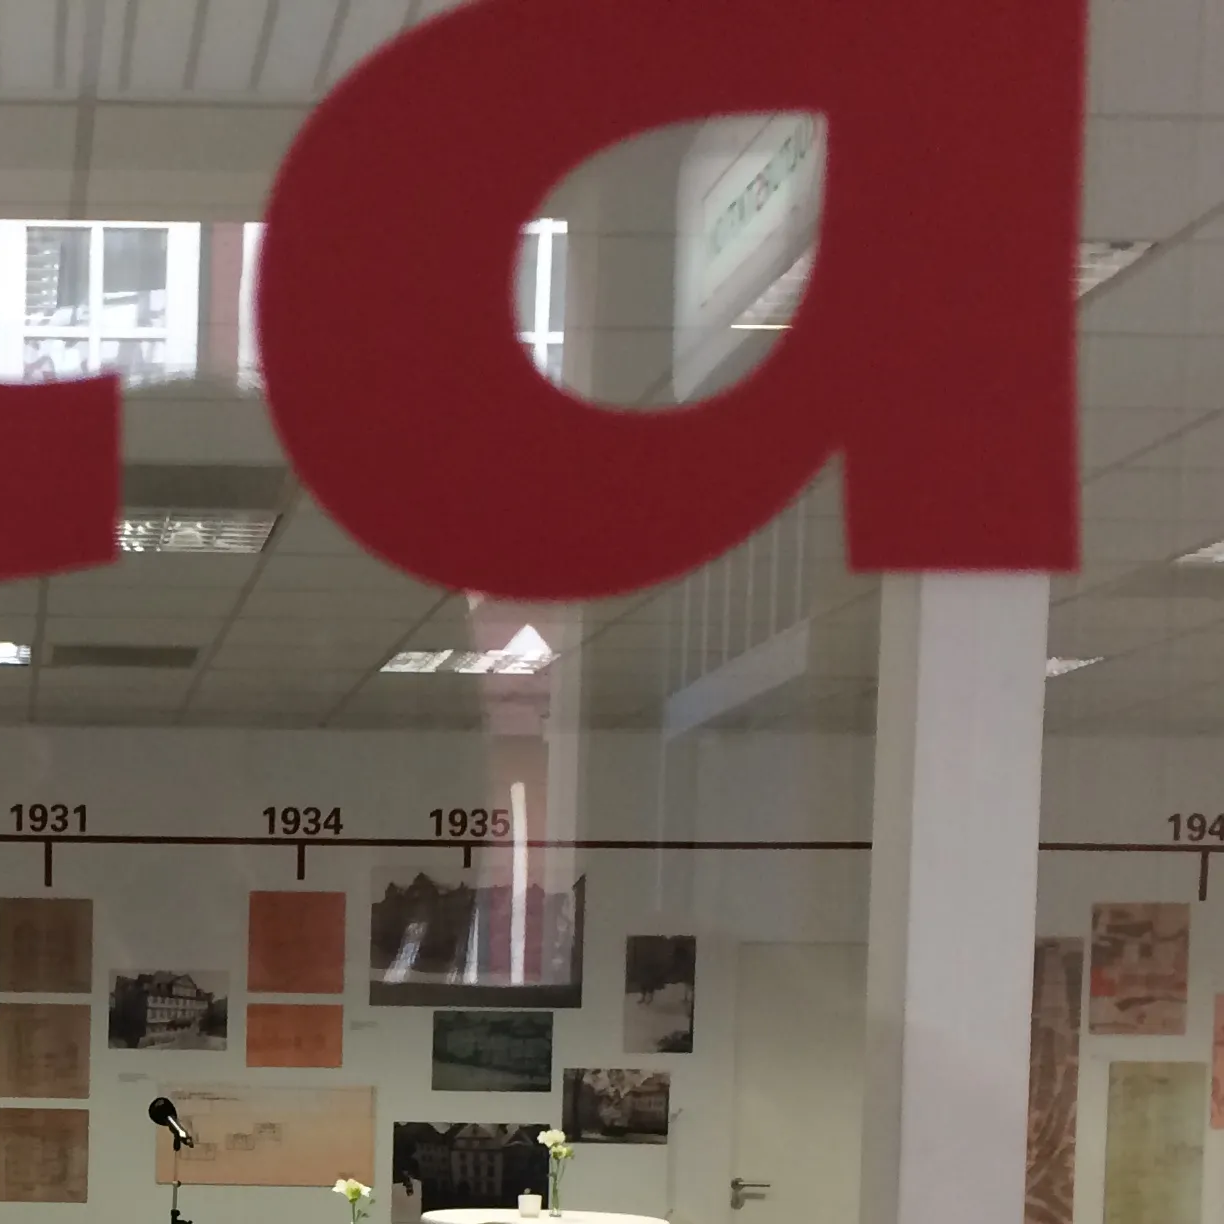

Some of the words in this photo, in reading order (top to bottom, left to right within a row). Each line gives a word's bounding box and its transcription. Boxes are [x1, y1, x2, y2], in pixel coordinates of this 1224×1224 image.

[10, 803, 87, 834] 1931
[262, 807, 344, 836] 1934
[428, 808, 511, 838] 1935
[1168, 812, 1224, 842] 194
